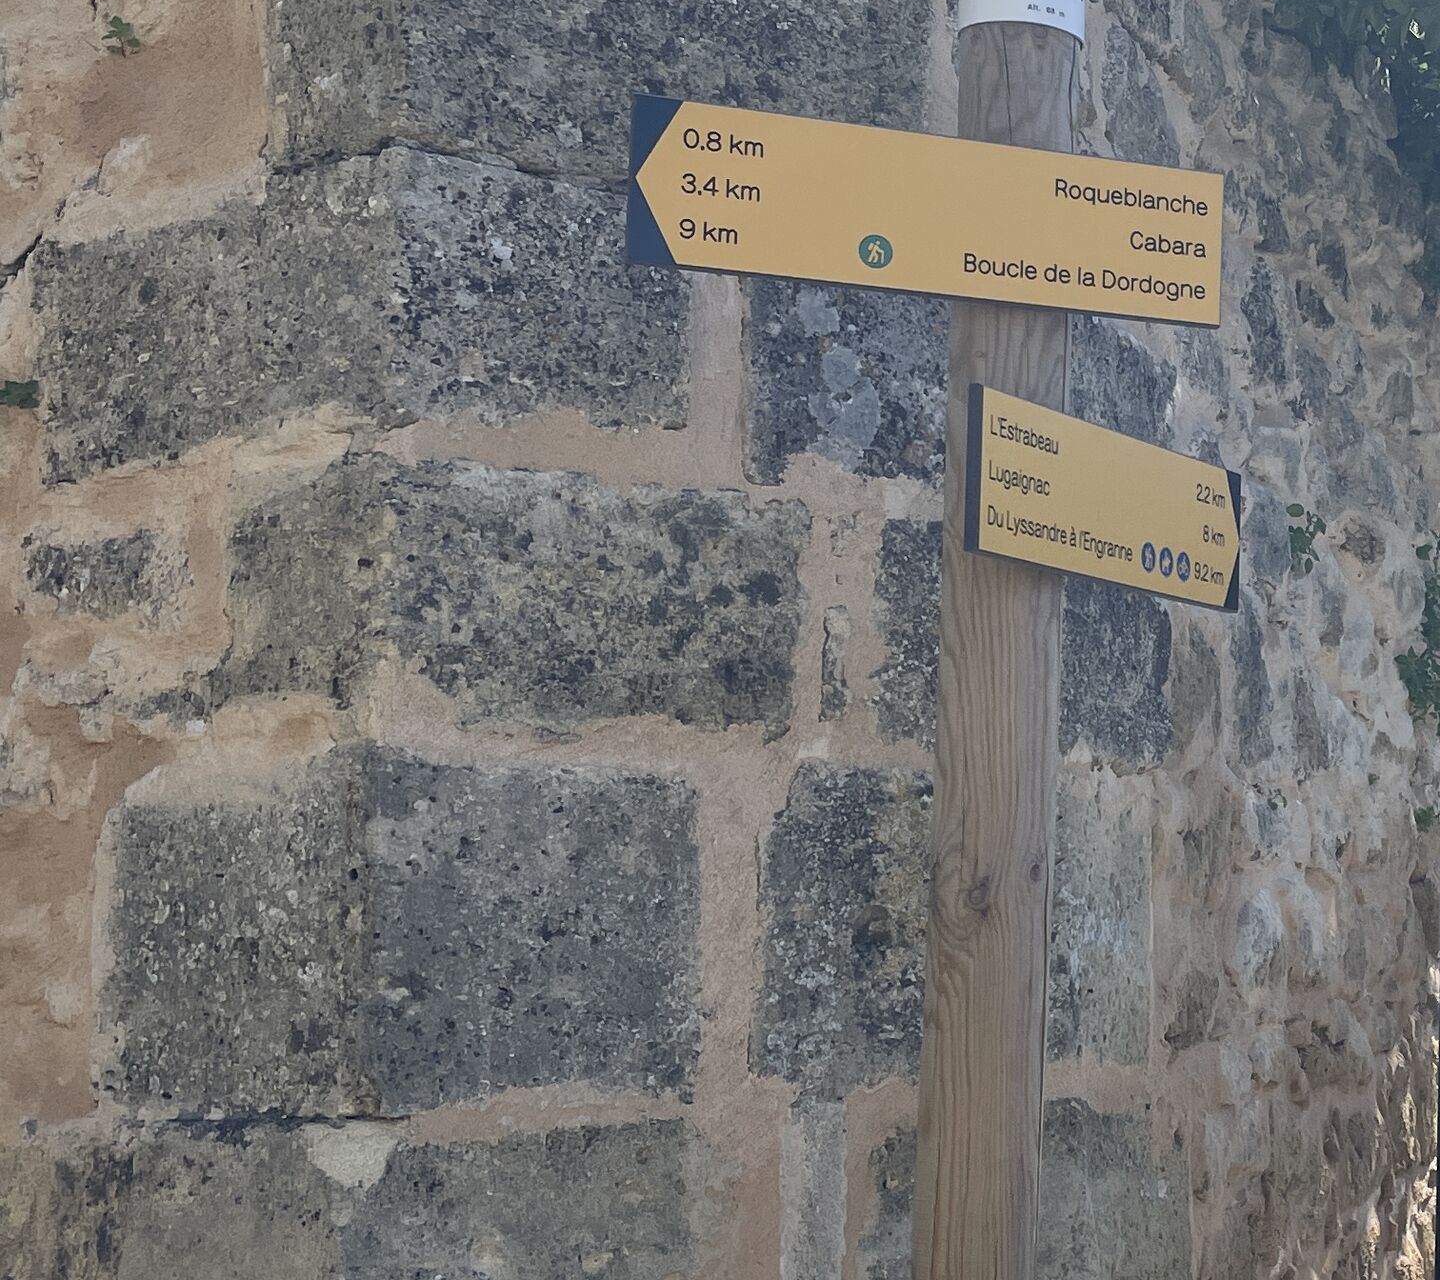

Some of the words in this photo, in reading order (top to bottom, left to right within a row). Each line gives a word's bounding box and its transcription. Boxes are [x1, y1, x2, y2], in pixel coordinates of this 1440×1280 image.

[683, 128, 722, 152] 0.8
[729, 134, 764, 158] km
[681, 173, 719, 197] 3.4
[726, 178, 760, 202] km
[1055, 178, 1209, 216] Roqueblanche
[679, 218, 696, 239] 9
[703, 221, 738, 245] km
[1129, 230, 1207, 258] Cabara
[963, 252, 1037, 281] Boucle
[1043, 263, 1071, 285] de
[1077, 266, 1096, 288] la
[1101, 269, 1206, 302] Dordogne
[990, 414, 1060, 455] L'Estrabeau
[988, 459, 1051, 496] Lugaignac
[1212, 488, 1226, 509] km
[987, 504, 1004, 529] Du
[1006, 510, 1067, 545] Lyssandre
[1069, 526, 1077, 548] à
[1079, 530, 1134, 562] l'Engranne
[1203, 524, 1210, 543] 8
[1211, 528, 1225, 547] km
[1210, 567, 1225, 586] km
